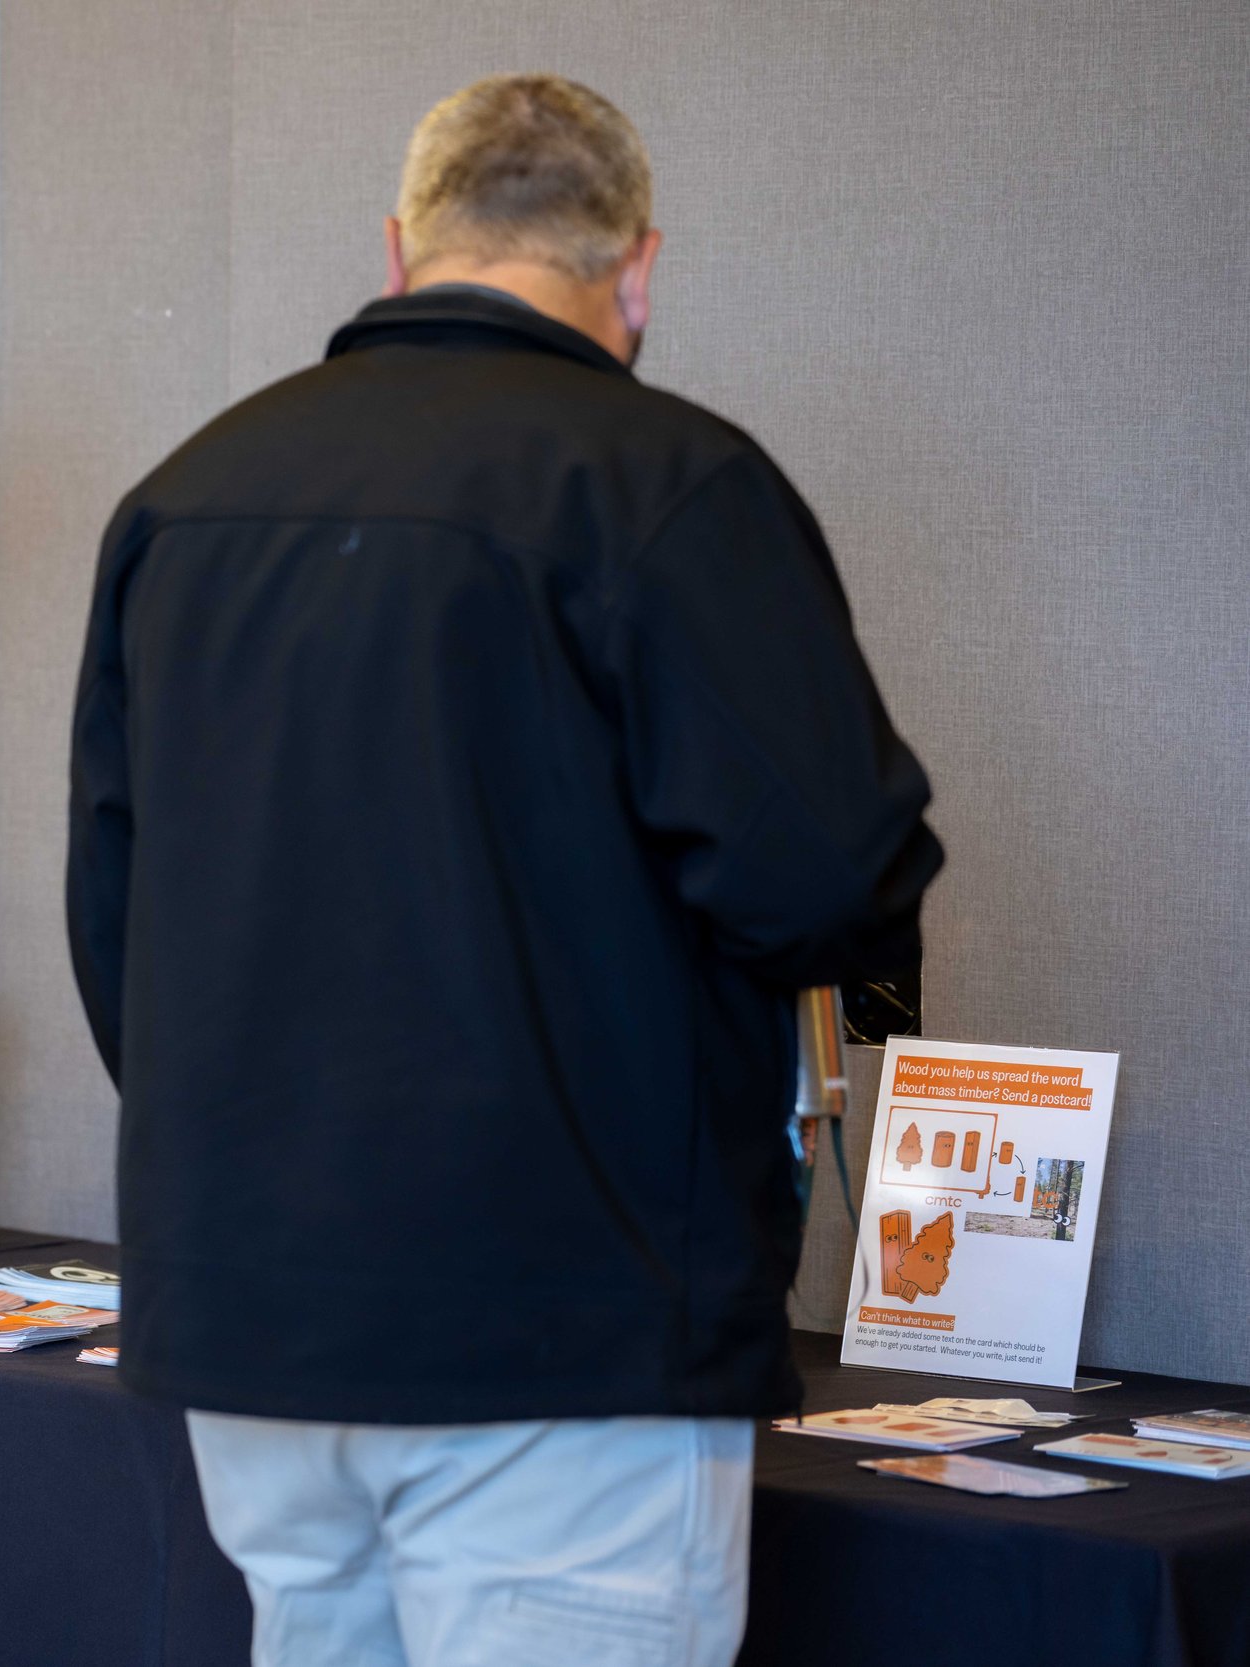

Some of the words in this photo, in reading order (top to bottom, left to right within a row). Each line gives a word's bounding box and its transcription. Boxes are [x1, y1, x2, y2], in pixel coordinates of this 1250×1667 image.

[898, 1061, 929, 1075] Wood
[930, 1066, 950, 1079] you
[952, 1065, 975, 1081] help
[977, 1070, 990, 1080] us
[991, 1070, 1029, 1084] spread
[1031, 1072, 1049, 1084] the
[1051, 1074, 1079, 1087] word
[895, 1081, 926, 1094] about
[927, 1086, 956, 1097] mass
[958, 1086, 1000, 1100] timber?
[1001, 1088, 1030, 1102] Send
[1031, 1094, 1038, 1103] a
[1039, 1093, 1092, 1107] postcard!
[925, 1195, 962, 1208] cmtc
[860, 1310, 881, 1321] Can't
[882, 1313, 902, 1324] think
[902, 1315, 921, 1326] what
[922, 1318, 930, 1327] to
[931, 1319, 955, 1329] write?
[855, 1338, 879, 1348] enough
[880, 1340, 887, 1348] to
[887, 1341, 898, 1350] get
[899, 1343, 912, 1351] you
[912, 1344, 937, 1353] started.
[940, 1346, 971, 1357] Whatever
[972, 1350, 985, 1359] you
[986, 1352, 1004, 1361] write,
[1004, 1353, 1017, 1363] just
[1018, 1356, 1035, 1364] send
[1035, 1356, 1043, 1365] it!
[857, 1325, 876, 1335] We've
[877, 1328, 901, 1339] already
[902, 1330, 922, 1340] added
[923, 1334, 940, 1342] some
[942, 1335, 954, 1343] text
[965, 1337, 976, 1346] the
[977, 1339, 992, 1348] card
[993, 1340, 1012, 1349] which
[1013, 1342, 1036, 1352] should
[1036, 1344, 1046, 1353] be
